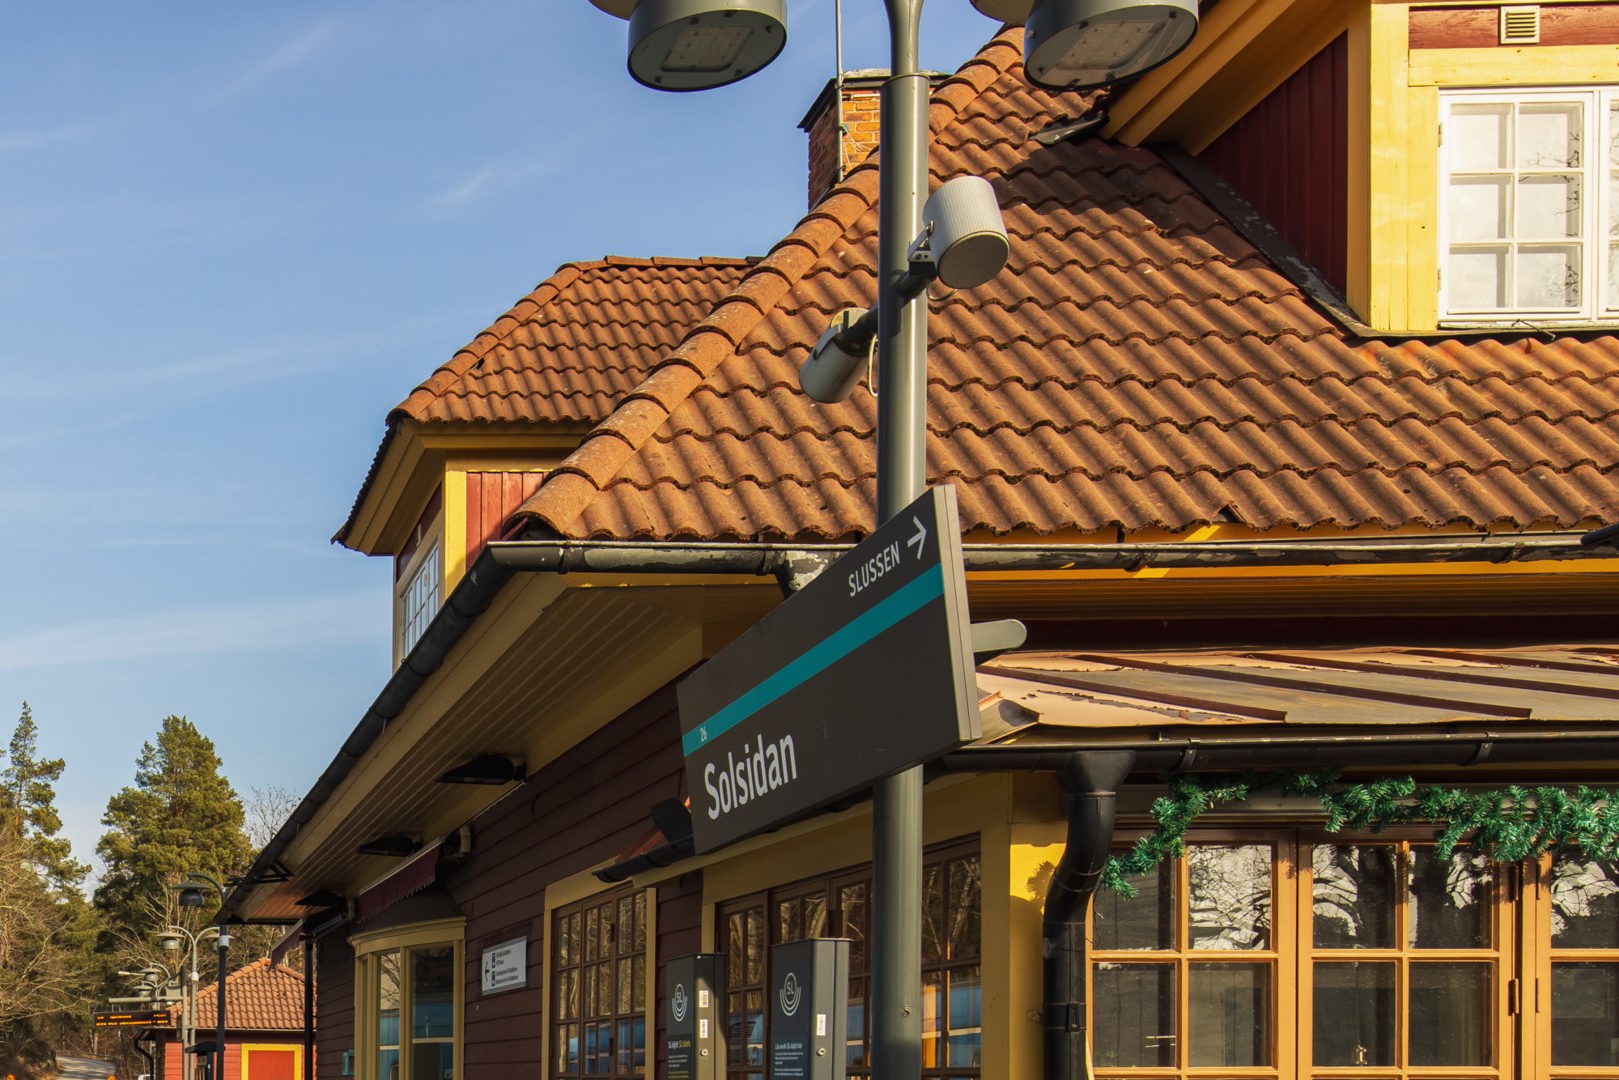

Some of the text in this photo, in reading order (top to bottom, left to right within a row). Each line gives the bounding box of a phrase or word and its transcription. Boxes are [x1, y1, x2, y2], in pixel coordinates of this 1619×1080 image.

[848, 540, 900, 597] SLUSSEN
[699, 726, 708, 742] 26
[704, 733, 797, 820] Solsidan
